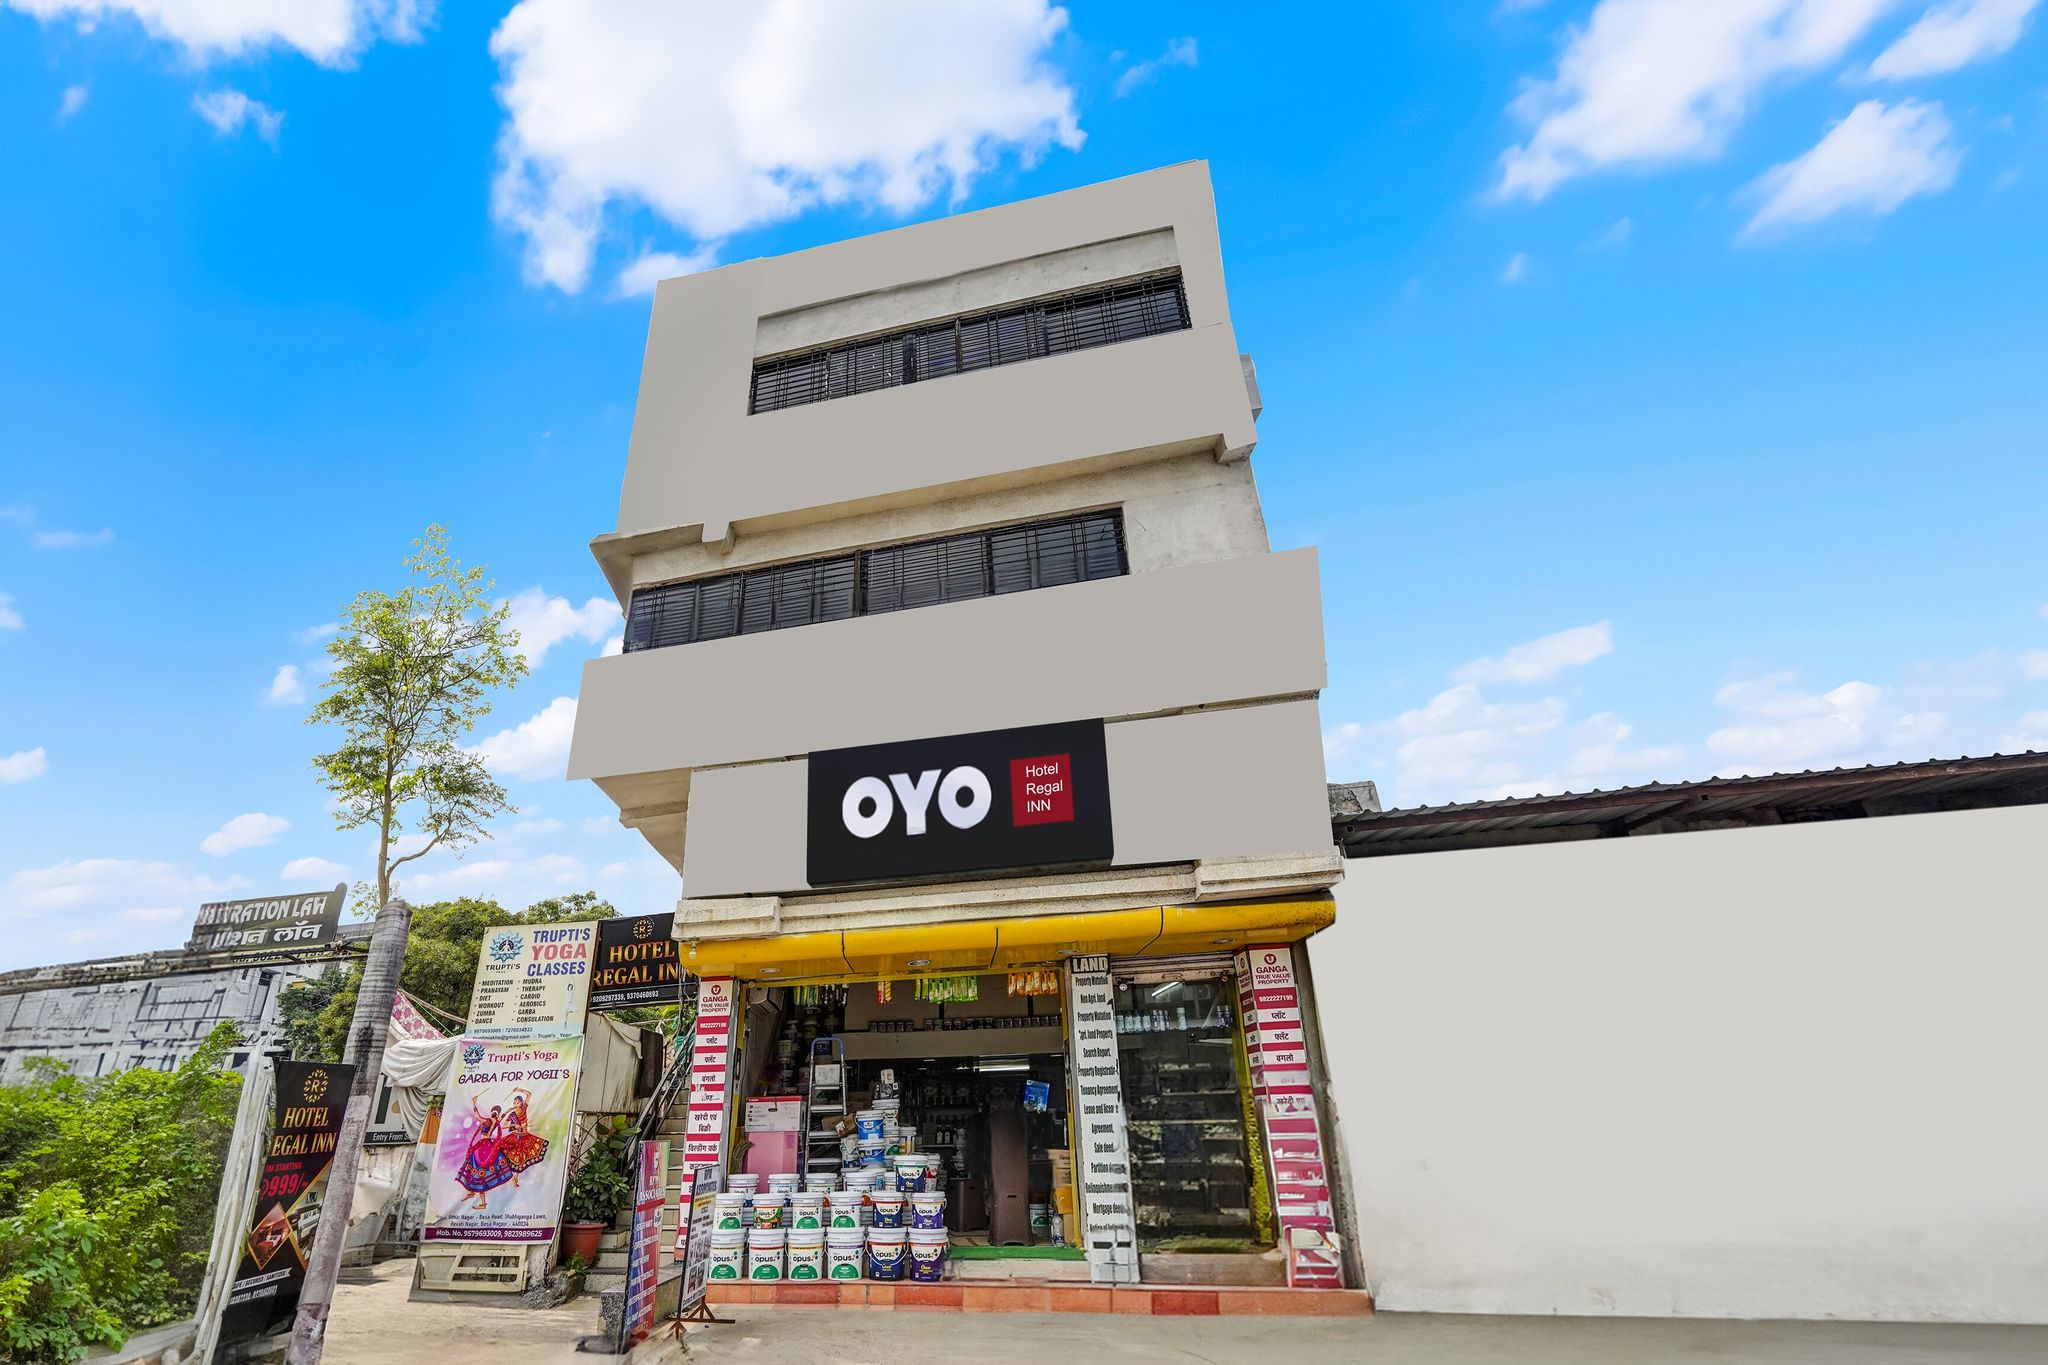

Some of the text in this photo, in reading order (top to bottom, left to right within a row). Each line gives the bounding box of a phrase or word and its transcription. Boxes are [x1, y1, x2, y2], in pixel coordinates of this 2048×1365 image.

[1025, 762, 1059, 778] Hotel
[1026, 779, 1063, 796] Regal
[842, 765, 992, 838] OYO
[1027, 799, 1051, 813] INN
[533, 928, 591, 943] TRUPTI'S
[531, 943, 587, 961] YOGA
[609, 940, 675, 964] HOTEL
[527, 961, 586, 977] CLASSES
[1072, 957, 1108, 972] LAND
[1256, 966, 1288, 974] GANGA
[703, 995, 728, 1003] GANGA
[488, 1050, 558, 1064] Trupti's Yoga
[458, 1072, 497, 1084] GARBA
[500, 1071, 524, 1082] FOR
[282, 1106, 329, 1128] HOTEL
[311, 1132, 337, 1153] INN
[373, 1132, 388, 1142] Entry
[389, 1132, 404, 1141] From
